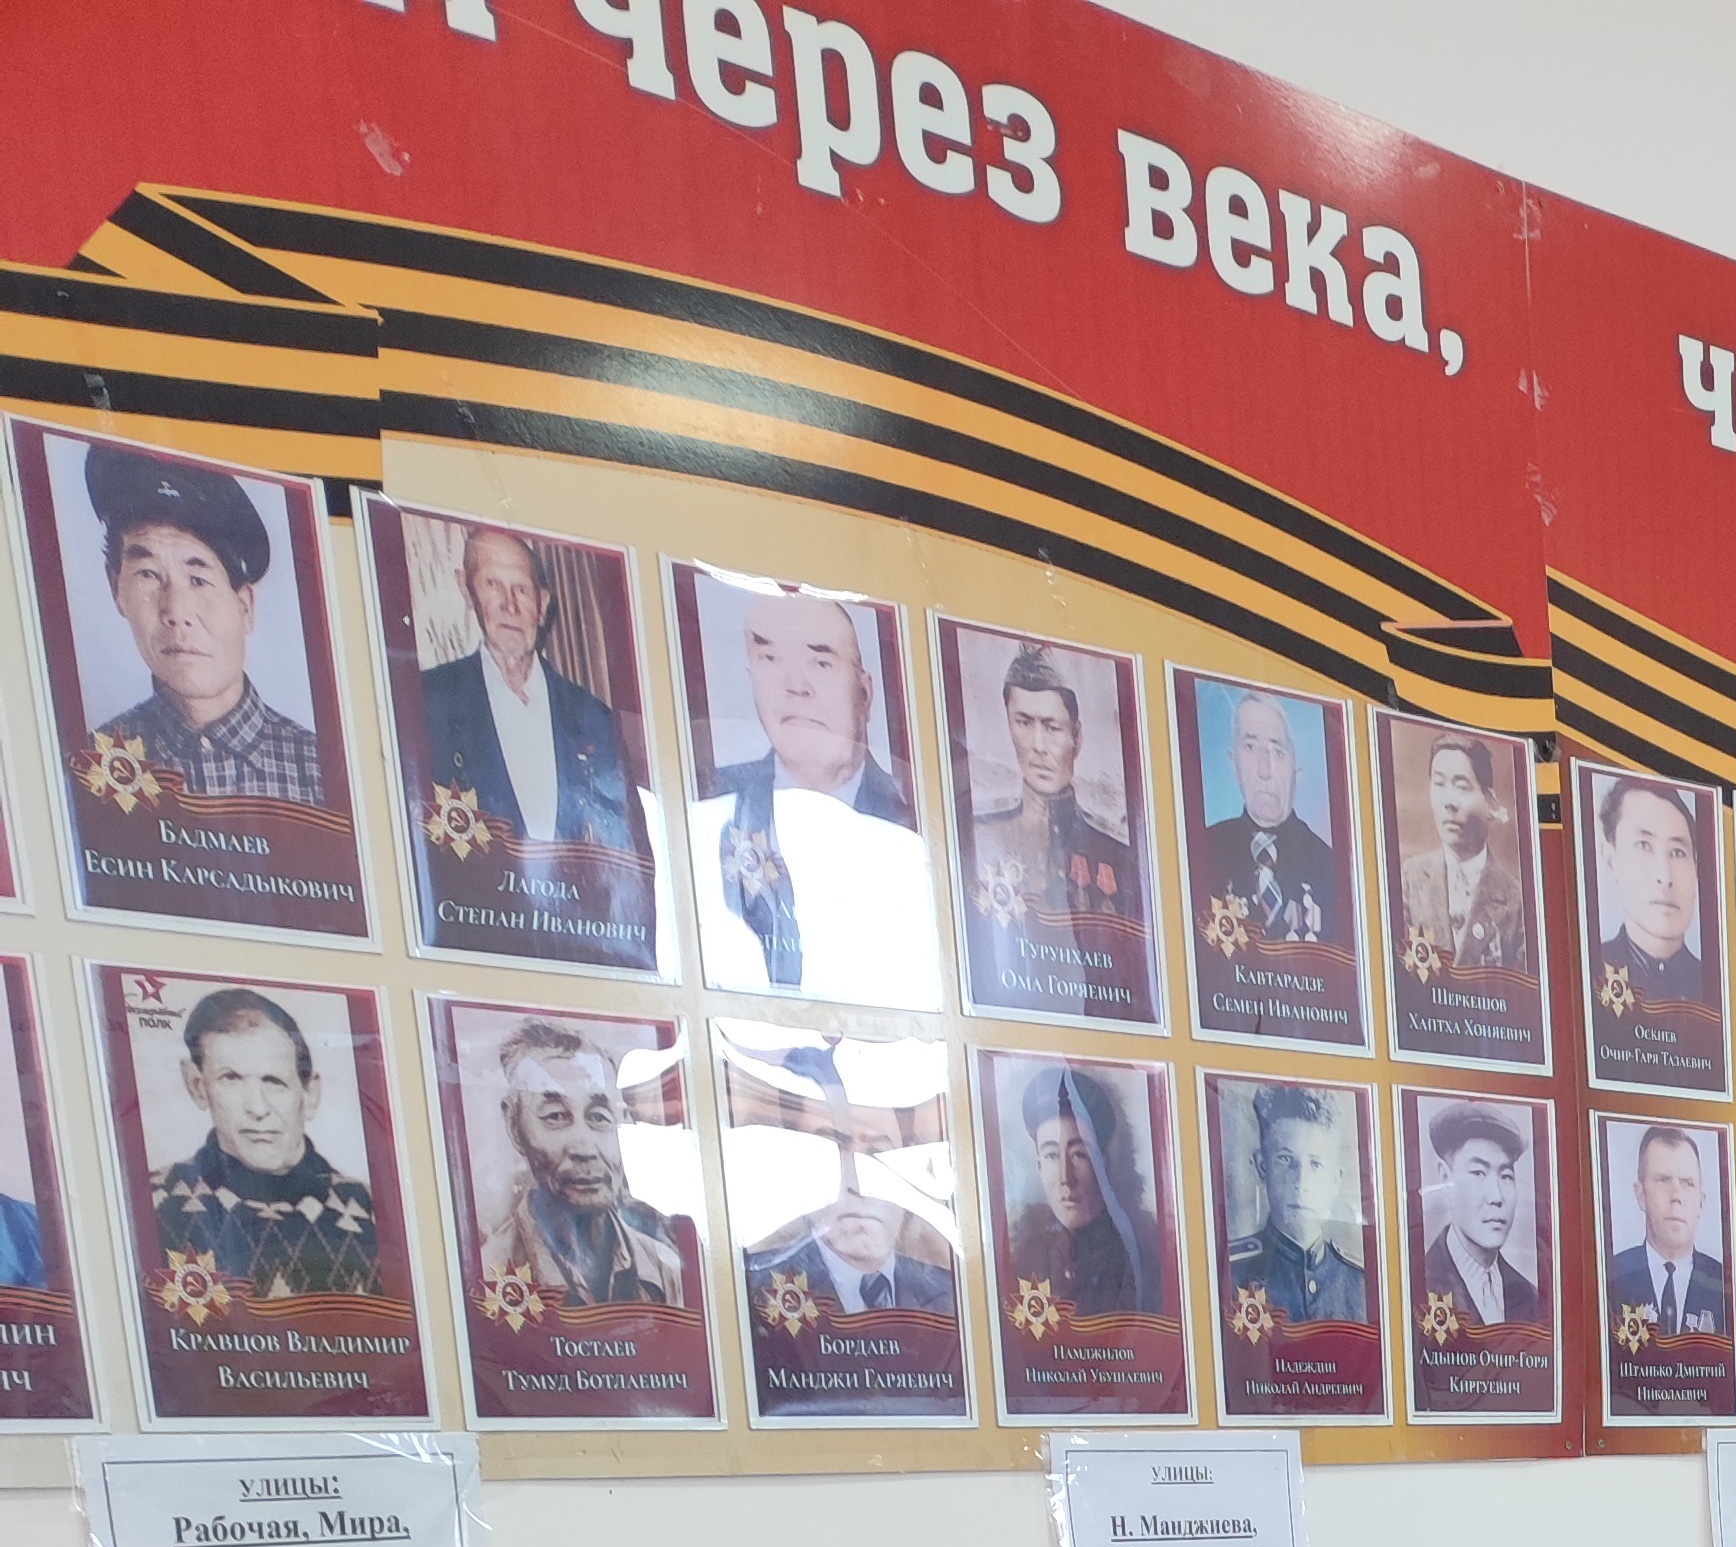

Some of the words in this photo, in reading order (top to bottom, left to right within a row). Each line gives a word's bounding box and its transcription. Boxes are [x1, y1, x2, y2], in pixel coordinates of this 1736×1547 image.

[1117, 128, 1466, 377] века,
[1150, 1465, 1214, 1483] УЛИЦЫ:
[173, 1515, 310, 1544] Рабочая,
[318, 1511, 411, 1541] Мира,
[1110, 1515, 1134, 1537] Н.
[1140, 1514, 1258, 1538] Манджиева,
